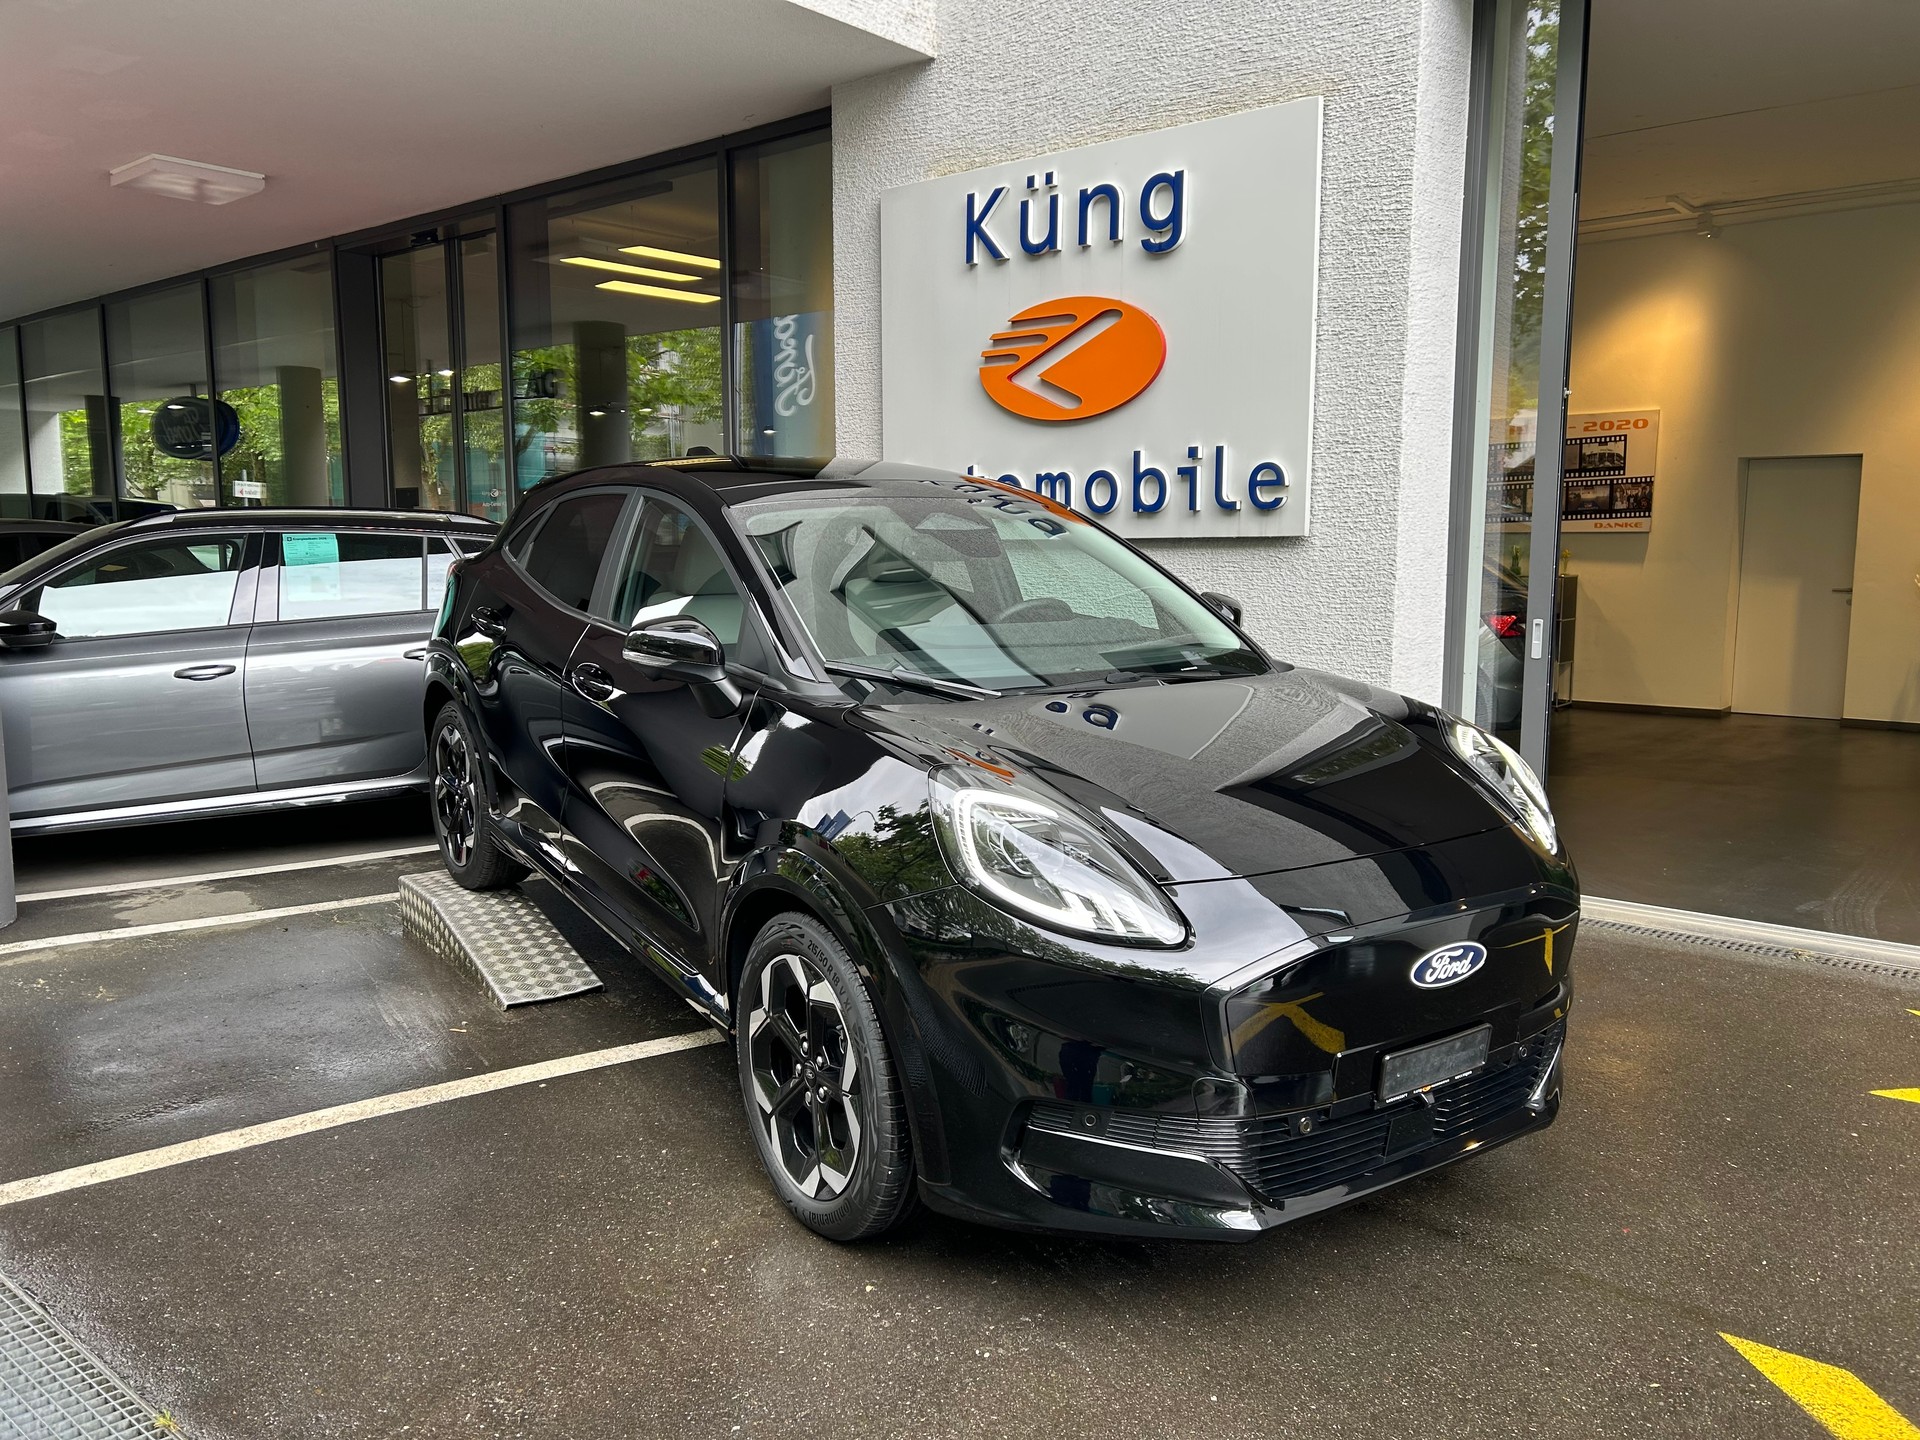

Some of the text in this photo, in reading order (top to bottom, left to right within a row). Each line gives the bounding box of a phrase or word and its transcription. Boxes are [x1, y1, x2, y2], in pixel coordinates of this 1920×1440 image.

[965, 169, 1190, 266] Küng
[1583, 418, 1649, 433] 2020
[966, 444, 1291, 515] mobile
[1593, 521, 1644, 529] DANKE
[806, 939, 829, 968] 215/50
[826, 964, 834, 976] R
[831, 972, 841, 987] 18
[1425, 948, 1475, 982] Ford
